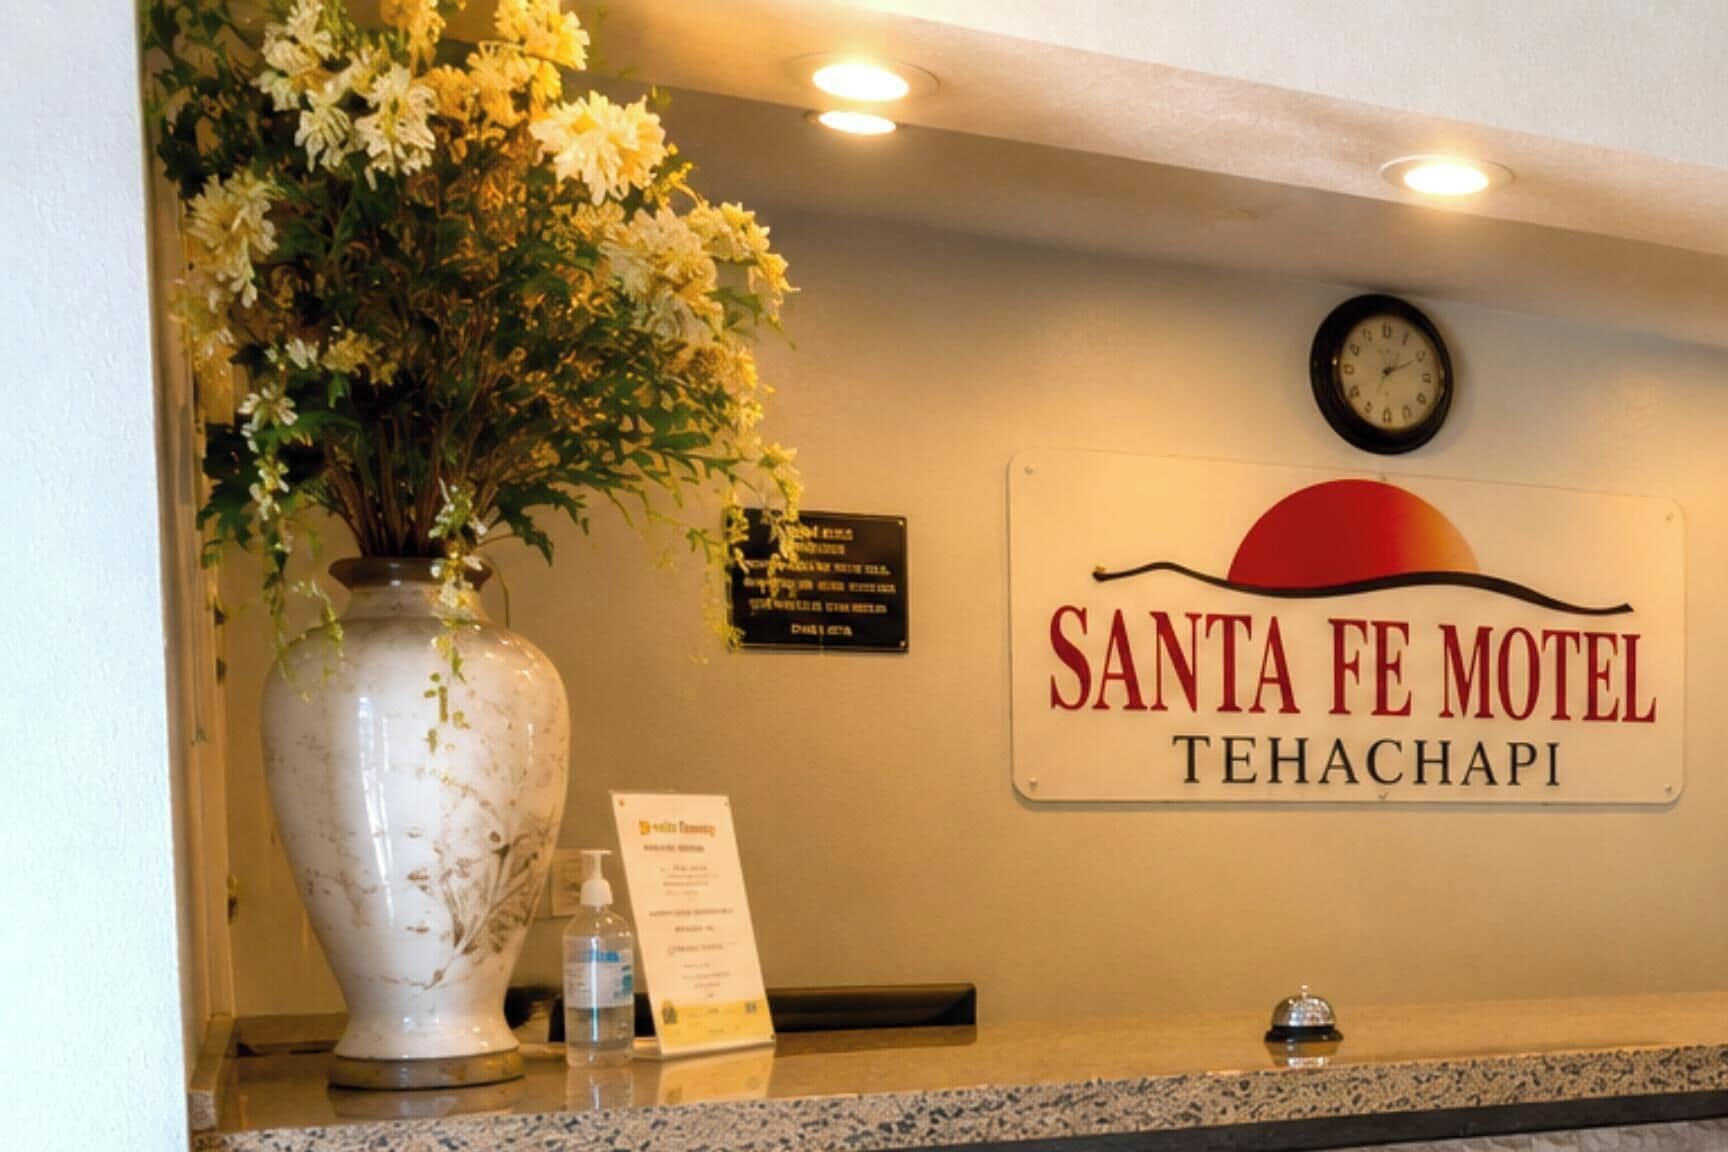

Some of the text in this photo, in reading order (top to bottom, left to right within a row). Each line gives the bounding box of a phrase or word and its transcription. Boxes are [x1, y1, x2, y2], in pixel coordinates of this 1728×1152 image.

[1048, 604, 1657, 723] SANTA FE MOTEL
[1172, 733, 1561, 788] TEHACHAPI
